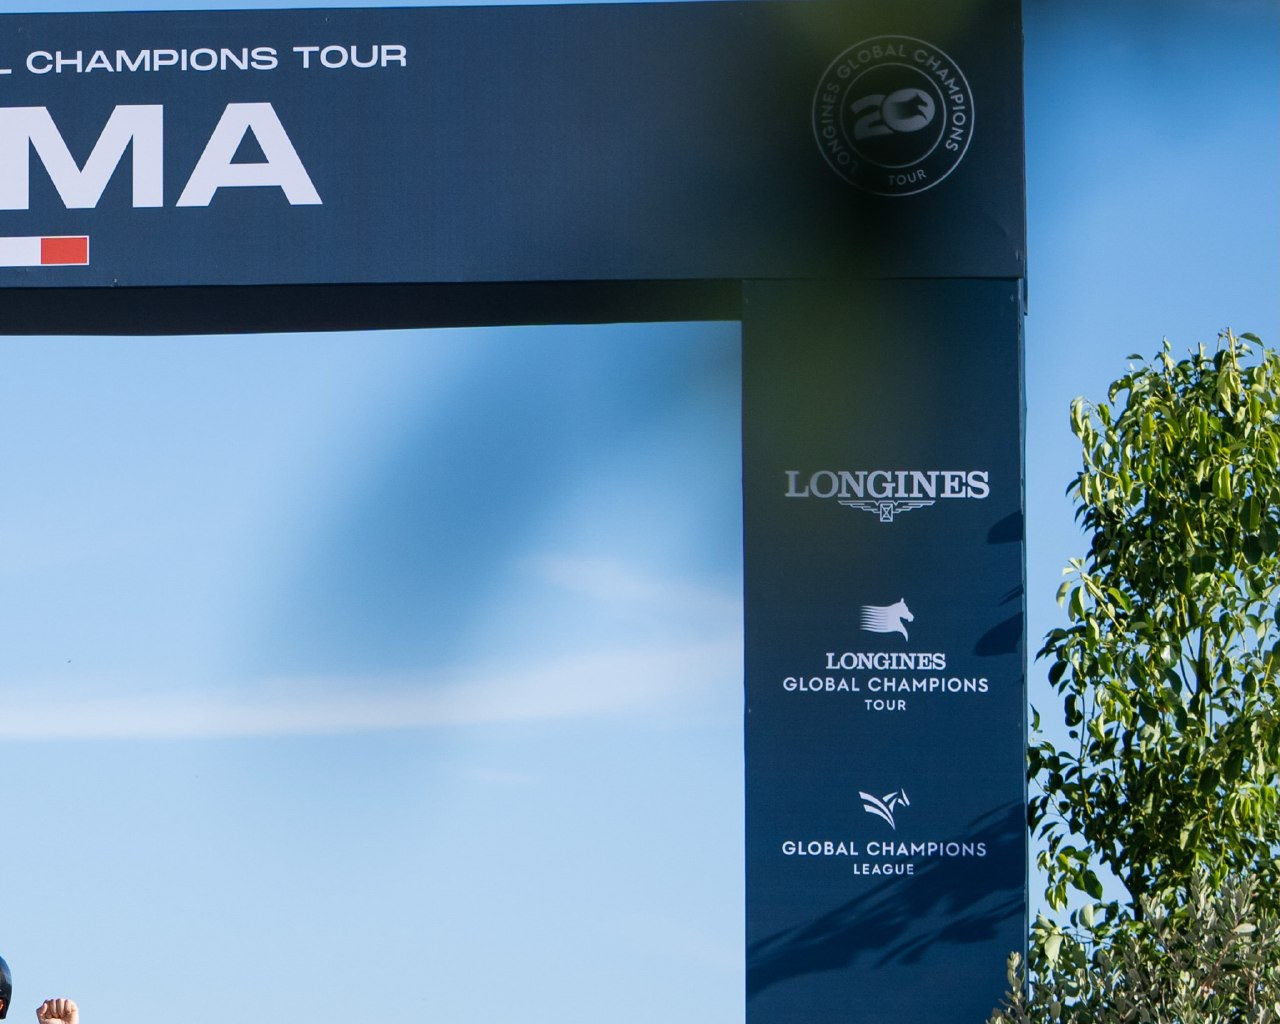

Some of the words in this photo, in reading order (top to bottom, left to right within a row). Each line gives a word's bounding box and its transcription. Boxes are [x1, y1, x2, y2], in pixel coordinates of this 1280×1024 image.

[26, 46, 279, 74] CHAMPIONS
[292, 44, 407, 69] TOUR
[837, 44, 907, 79] GLOBAL
[913, 49, 966, 152] CHAMPIONS
[821, 82, 858, 174] LONGINES
[888, 169, 926, 186] TOUR
[785, 470, 990, 498] LONGINES
[825, 652, 947, 670] LONGINES
[782, 676, 860, 692] GLOBAL
[867, 677, 989, 693] CHAMPIONS
[864, 699, 907, 711] TOUR
[781, 840, 859, 856] GLOBAL
[866, 841, 987, 857] CHAMPIONS
[853, 863, 915, 876] LEAGUE
